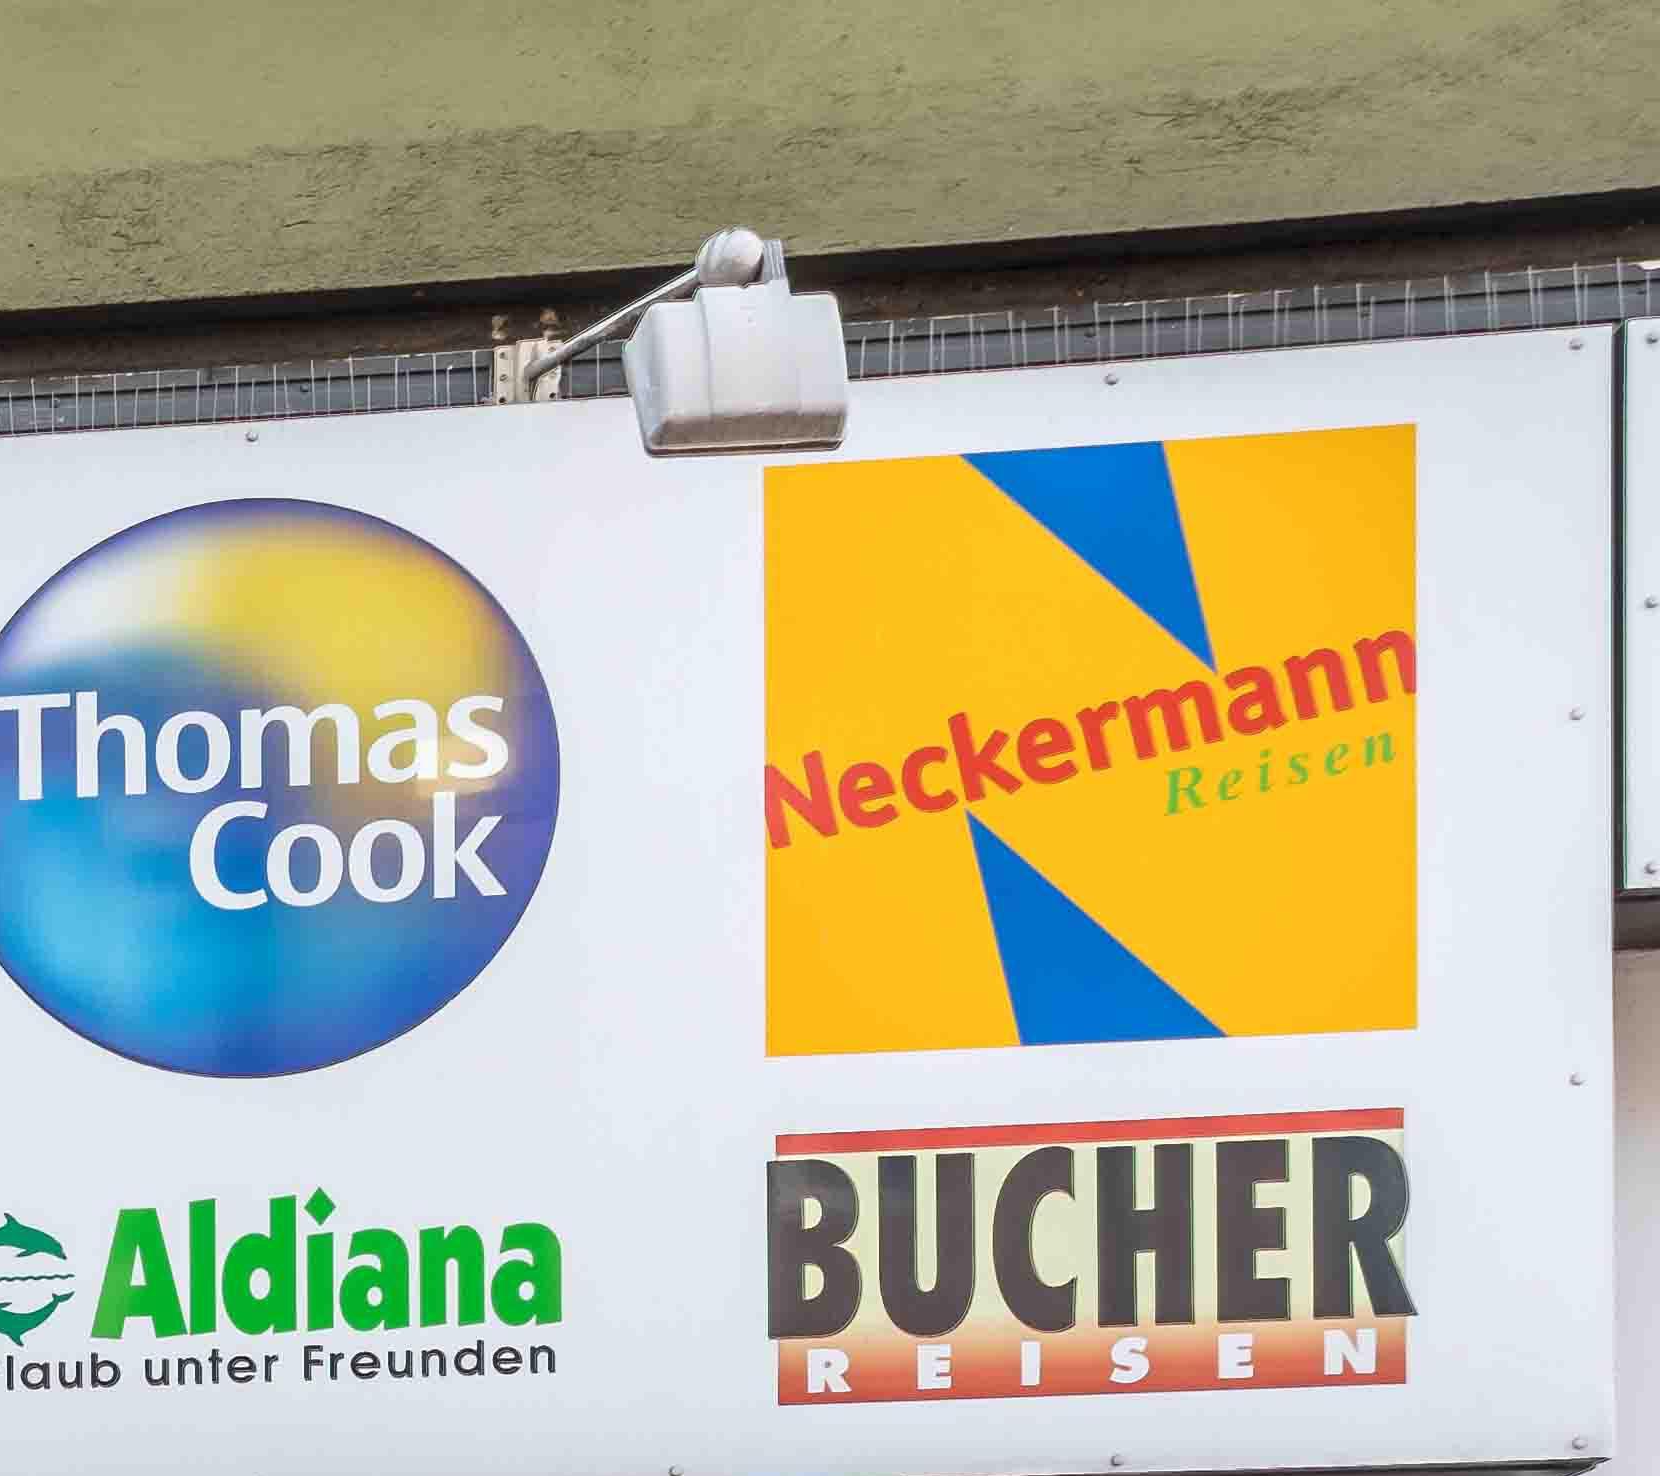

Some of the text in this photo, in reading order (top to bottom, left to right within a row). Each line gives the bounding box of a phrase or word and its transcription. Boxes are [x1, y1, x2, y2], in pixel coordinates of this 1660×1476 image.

[766, 625, 1417, 850] Neckermann
[1160, 724, 1404, 820] Reisen
[188, 794, 510, 912] Cook
[90, 1184, 563, 1341] Aldiana
[764, 1134, 1419, 1340] BUCHER
[143, 1352, 285, 1390] unter
[300, 1338, 561, 1380] Freunden
[802, 1329, 1381, 1395] REISEN
